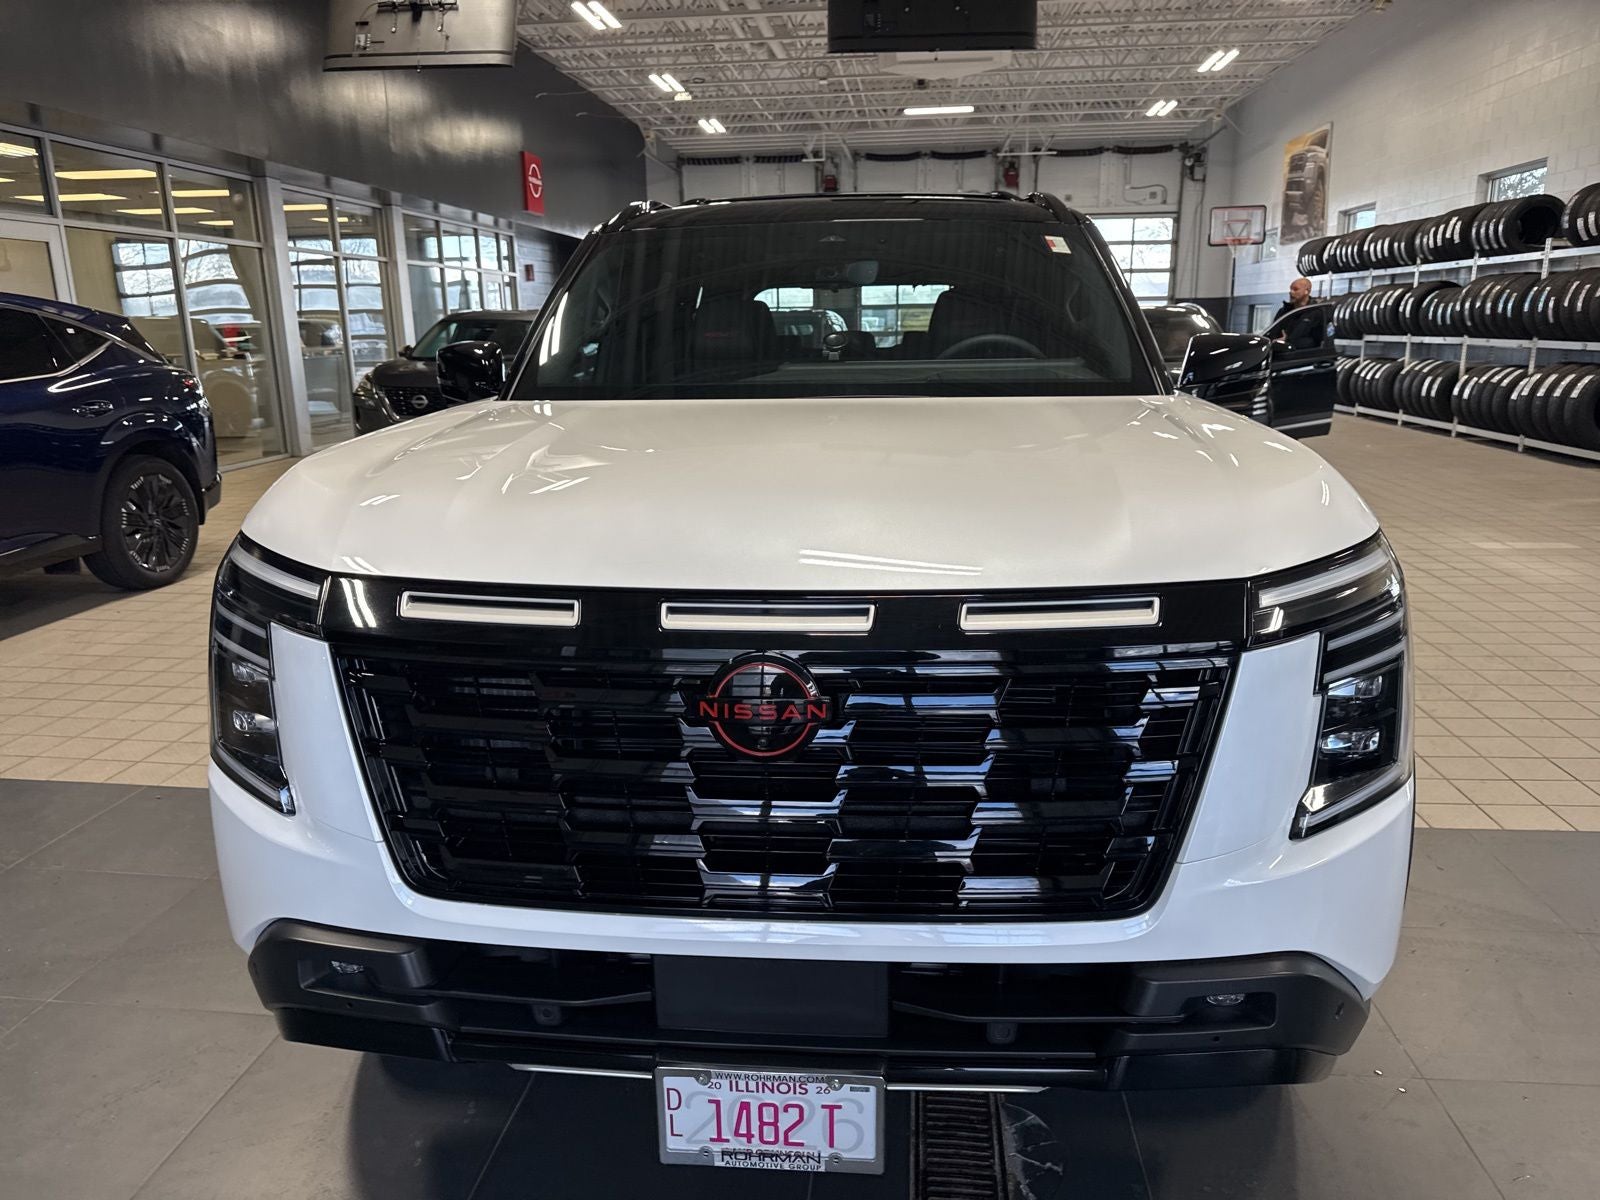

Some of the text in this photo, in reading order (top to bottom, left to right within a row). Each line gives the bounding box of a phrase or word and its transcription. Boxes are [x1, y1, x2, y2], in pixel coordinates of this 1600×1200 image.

[699, 701, 827, 721] NISSAN
[714, 1072, 826, 1084] WWW.ROHRMAN.COM
[708, 1080, 831, 1096] 20 ILLINOIS 26
[707, 1098, 843, 1149] 1482 T
[720, 1149, 822, 1165] ROHRMAN
[724, 1160, 822, 1172] AUTOMOTIVE GROUP
